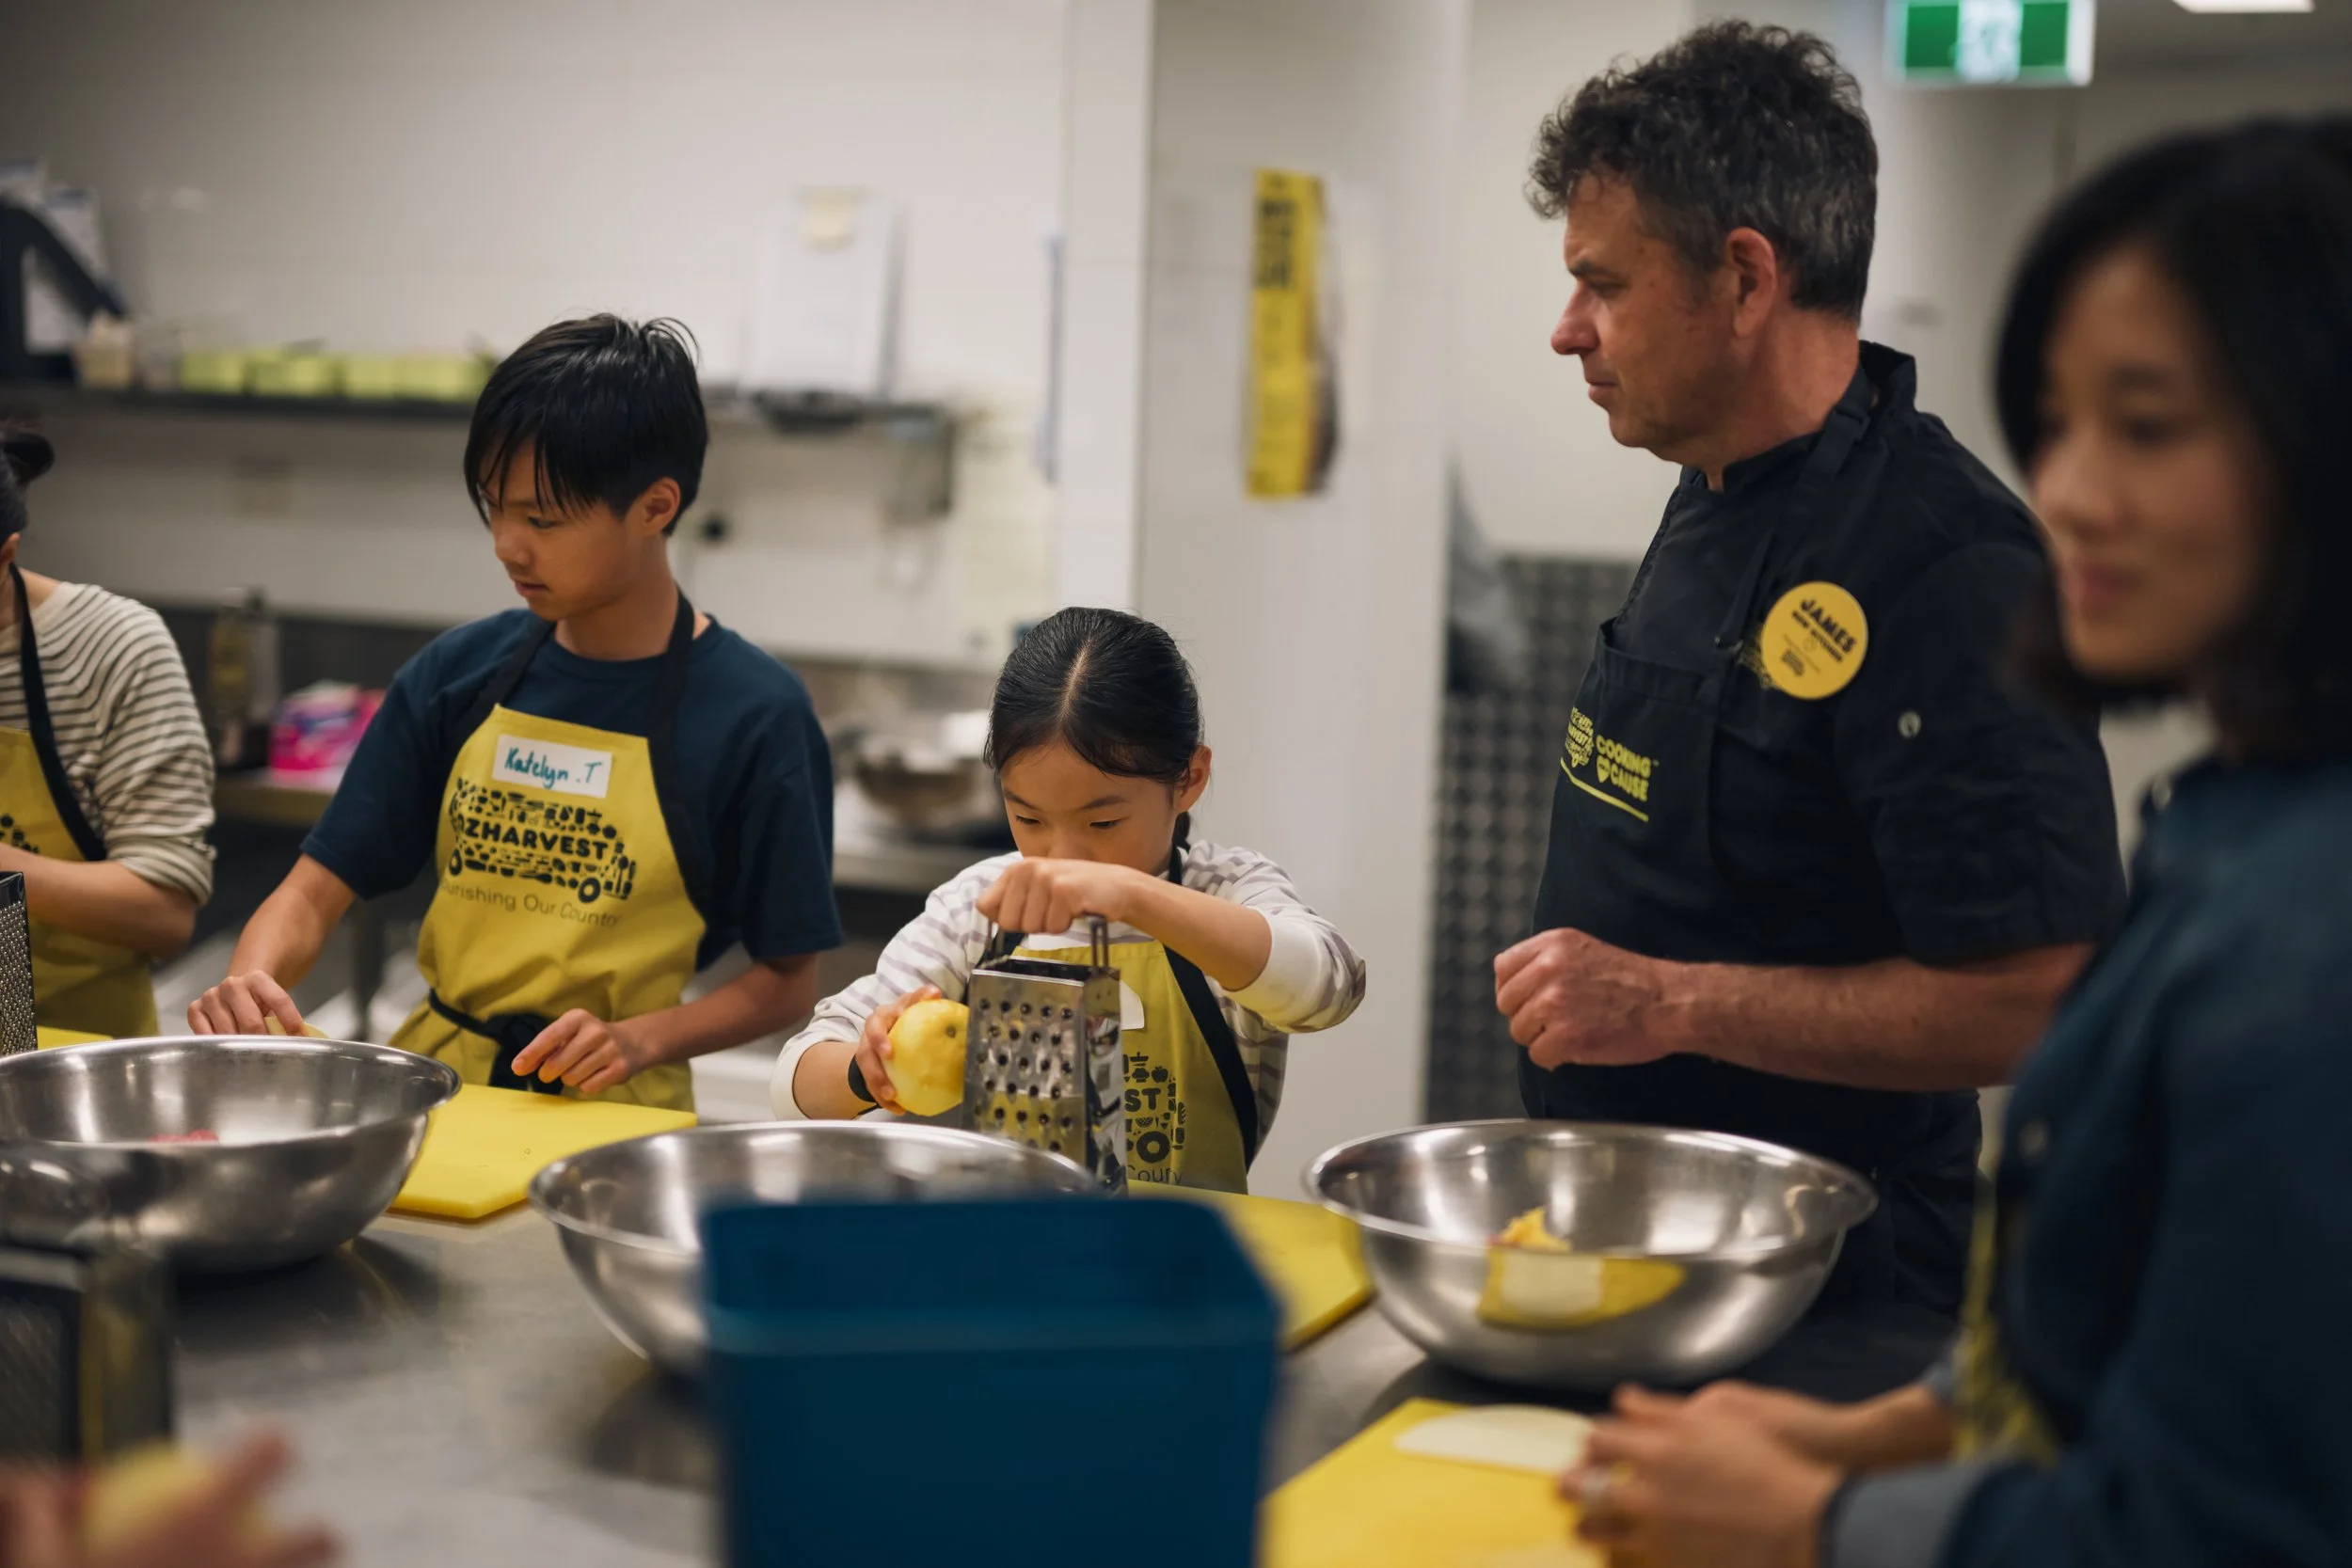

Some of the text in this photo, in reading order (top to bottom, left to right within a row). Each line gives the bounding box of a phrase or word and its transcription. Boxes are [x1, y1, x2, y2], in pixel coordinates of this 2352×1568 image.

[1800, 599, 1856, 655] JAMES
[504, 748, 568, 789] Katelyn
[1596, 735, 1651, 779] COOKING
[523, 894, 556, 915] Our
